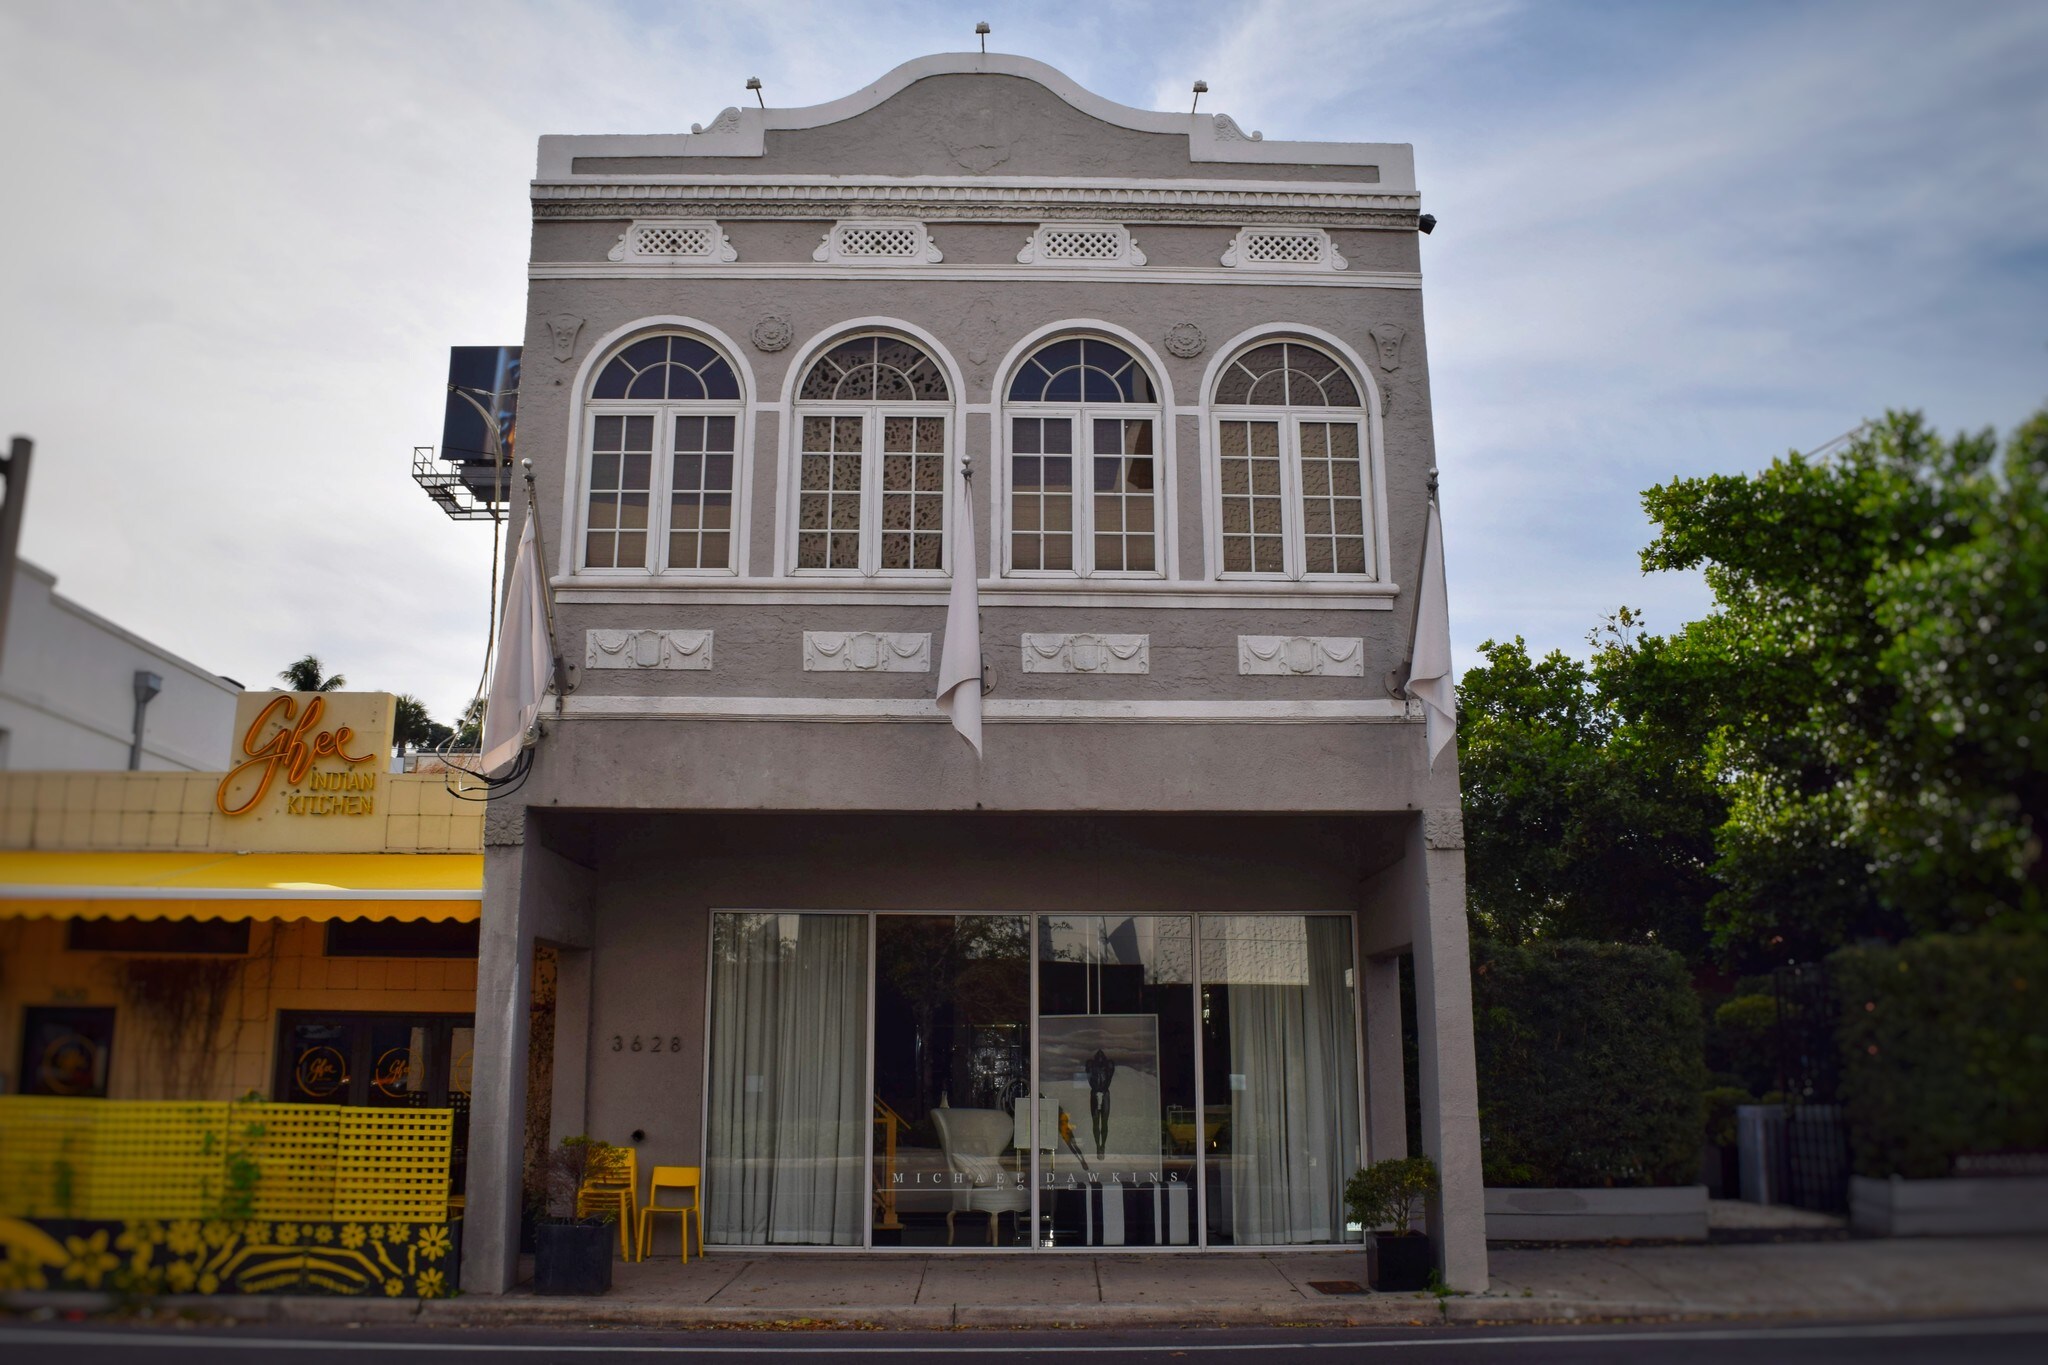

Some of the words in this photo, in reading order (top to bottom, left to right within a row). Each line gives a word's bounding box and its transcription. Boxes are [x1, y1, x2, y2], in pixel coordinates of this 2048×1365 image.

[217, 695, 376, 815] Ghee
[309, 772, 376, 791] INDIAN
[287, 796, 374, 815] KITCHEN
[611, 1035, 681, 1053] 3628
[892, 1173, 1025, 1184] MICHAEL
[1046, 1172, 1179, 1183] DAWKINS
